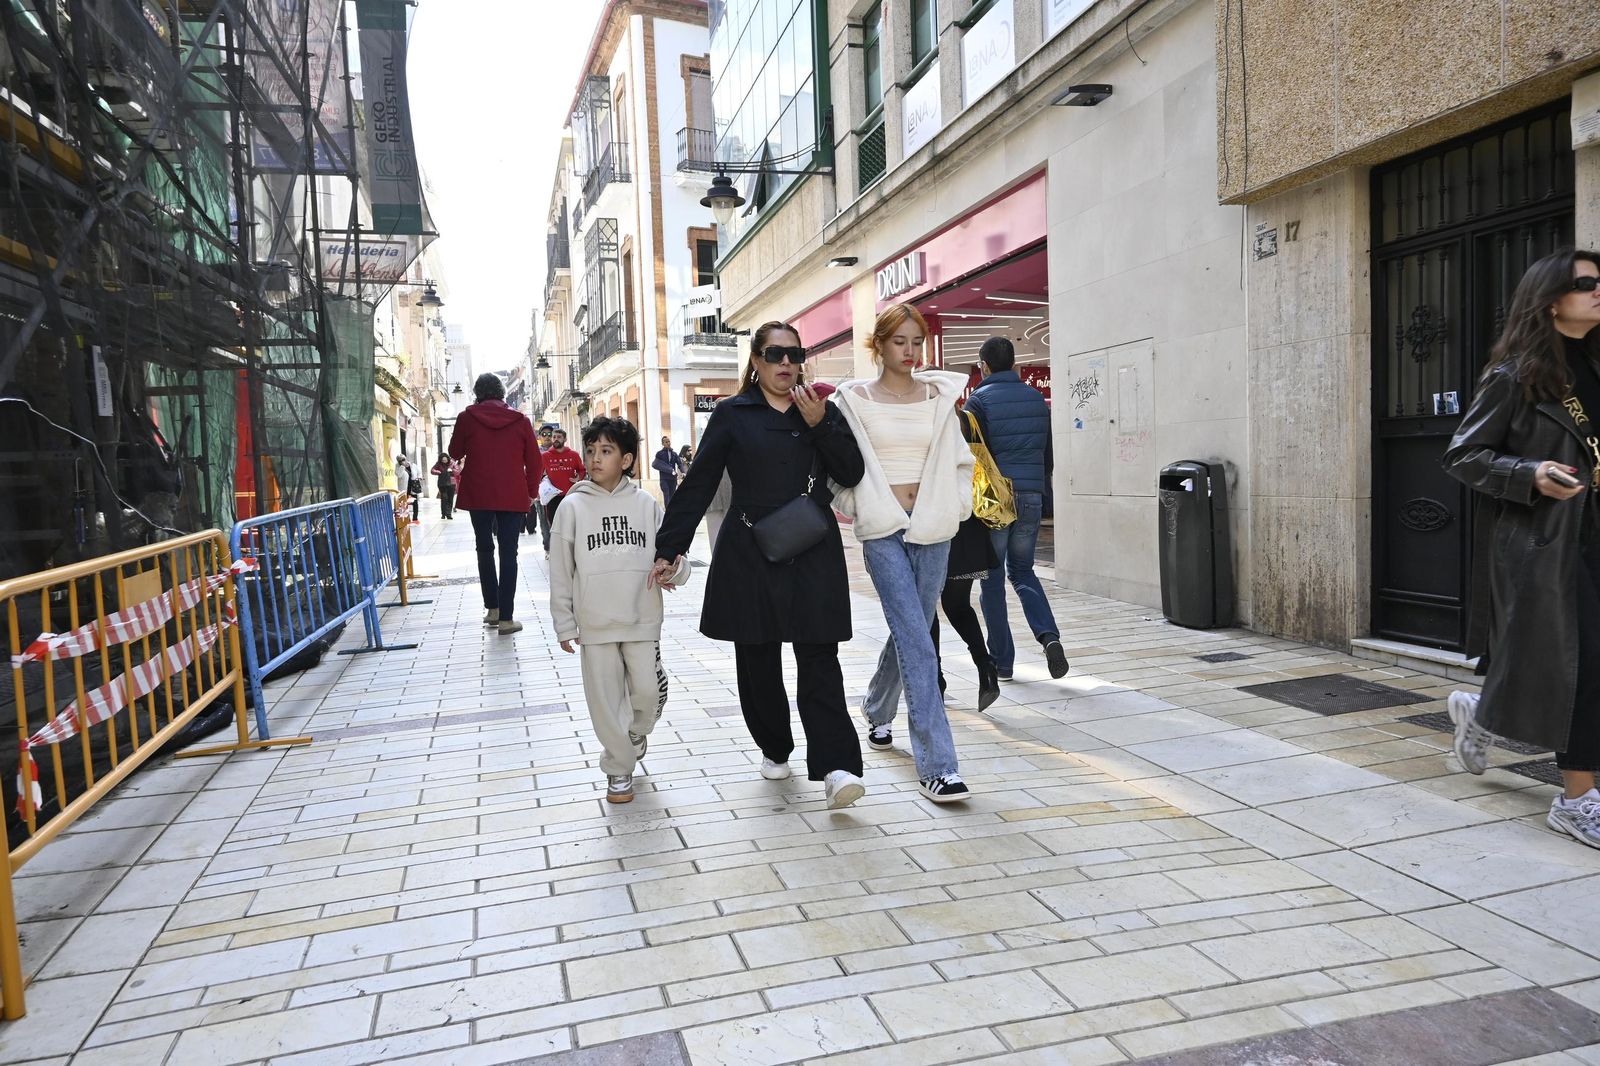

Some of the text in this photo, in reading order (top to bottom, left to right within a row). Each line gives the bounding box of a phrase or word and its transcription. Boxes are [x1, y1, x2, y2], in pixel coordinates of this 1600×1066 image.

[382, 56, 400, 143] INDUSTRIAL
[373, 101, 387, 143] GEKO
[1285, 220, 1301, 242] 17
[877, 252, 921, 301] DRUNI
[602, 515, 632, 532] ATH.
[587, 530, 646, 551] DIVISION
